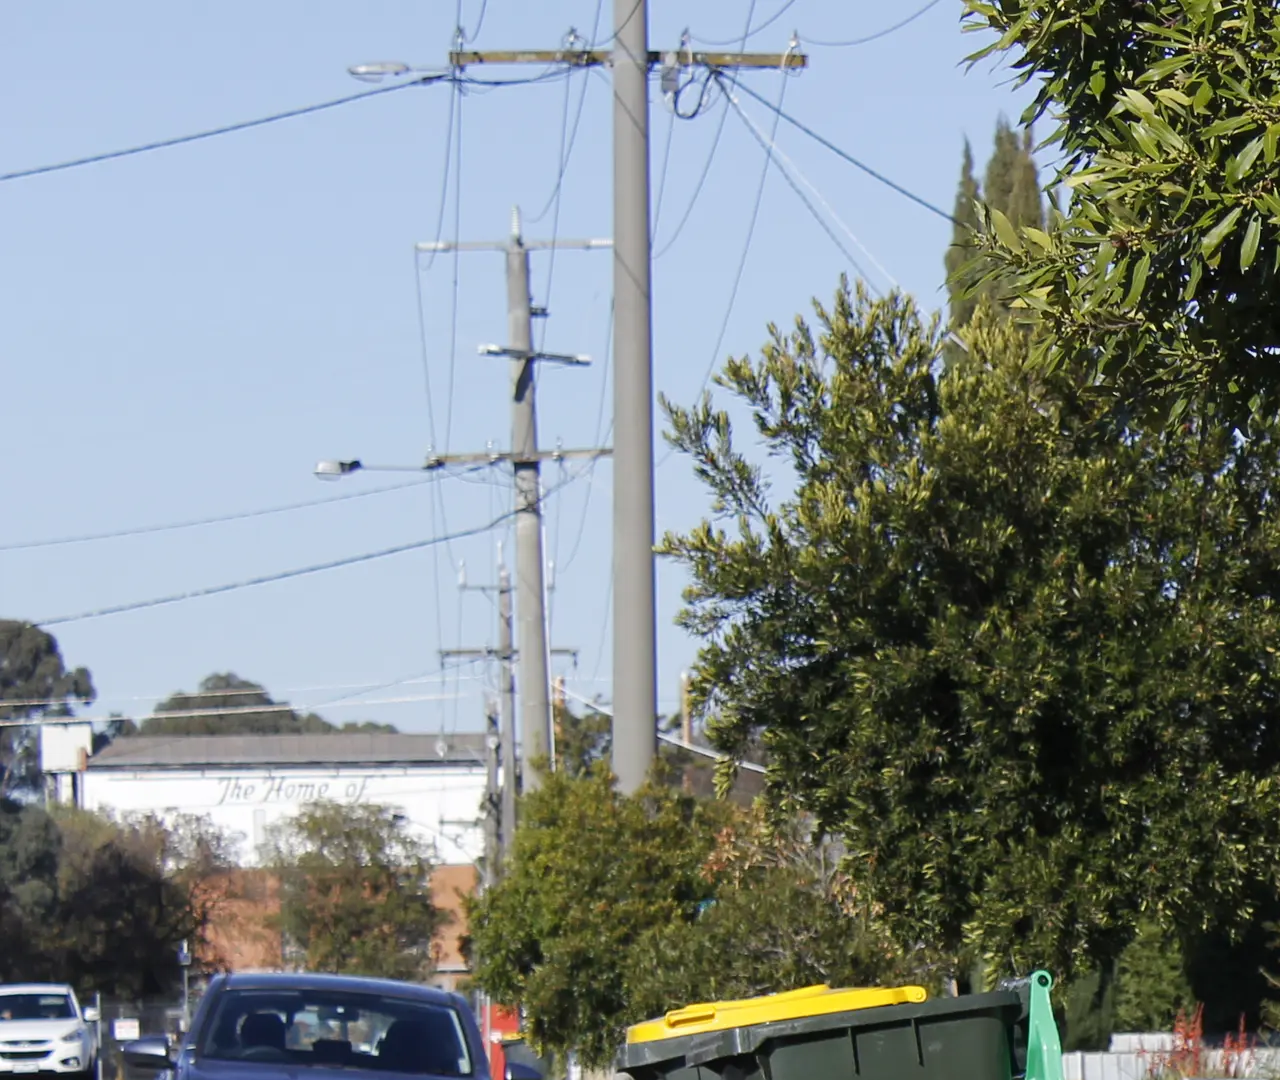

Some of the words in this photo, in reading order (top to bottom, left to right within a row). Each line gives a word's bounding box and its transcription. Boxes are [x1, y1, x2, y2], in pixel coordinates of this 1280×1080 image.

[219, 776, 255, 805] The
[263, 776, 329, 802] Home
[345, 775, 373, 803] of
